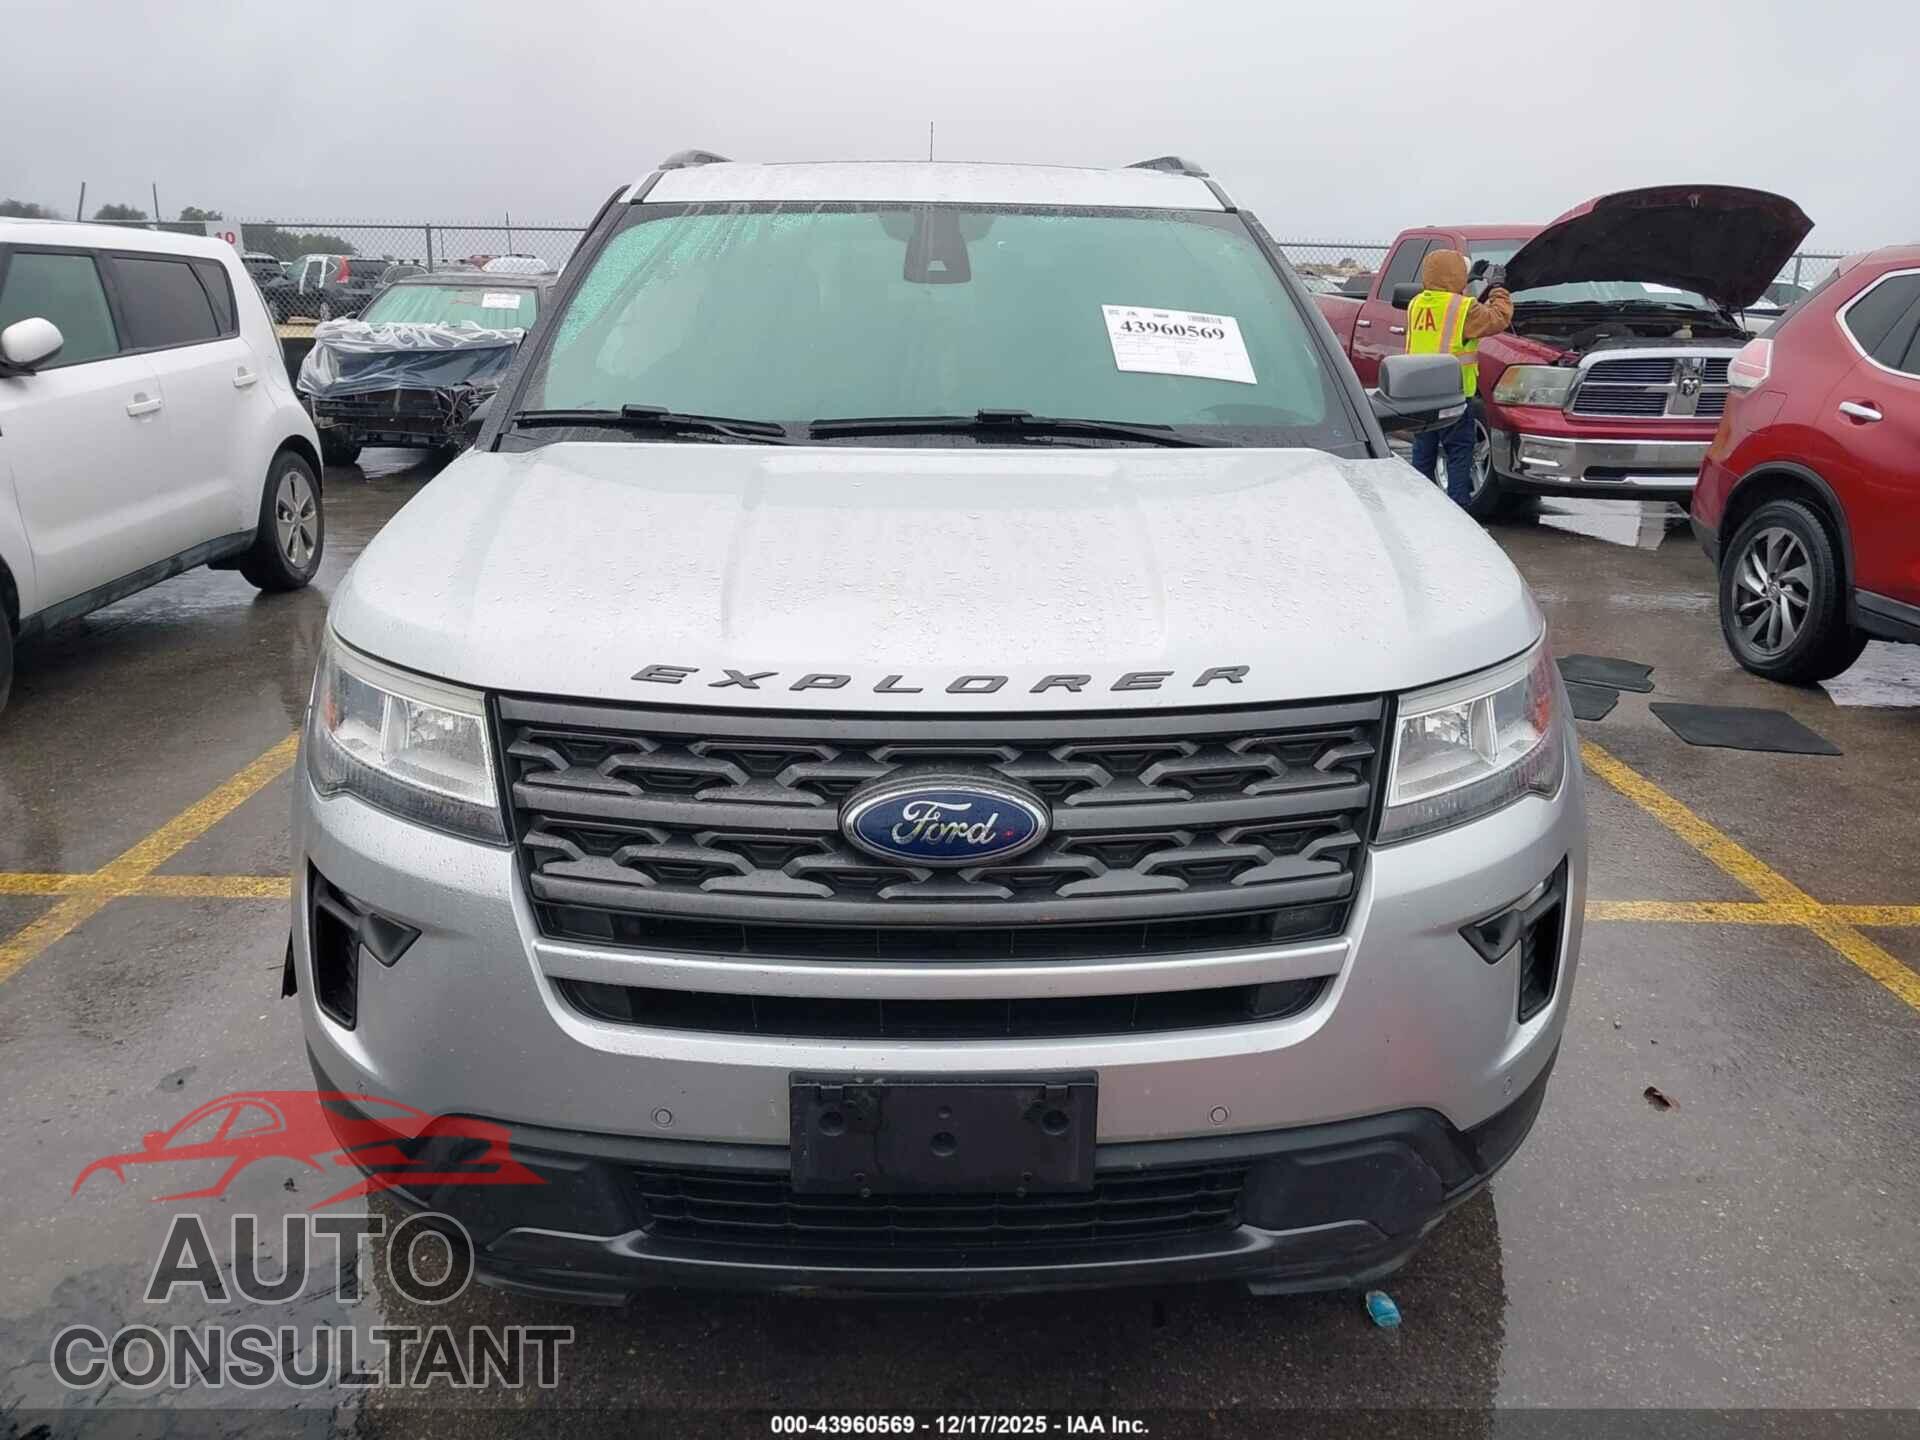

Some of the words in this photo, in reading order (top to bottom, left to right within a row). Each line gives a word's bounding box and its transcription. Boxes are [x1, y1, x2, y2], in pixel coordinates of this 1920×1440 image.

[1120, 320, 1225, 340] 43960569
[630, 664, 1250, 693] EXPLORER
[892, 801, 999, 845] Ford
